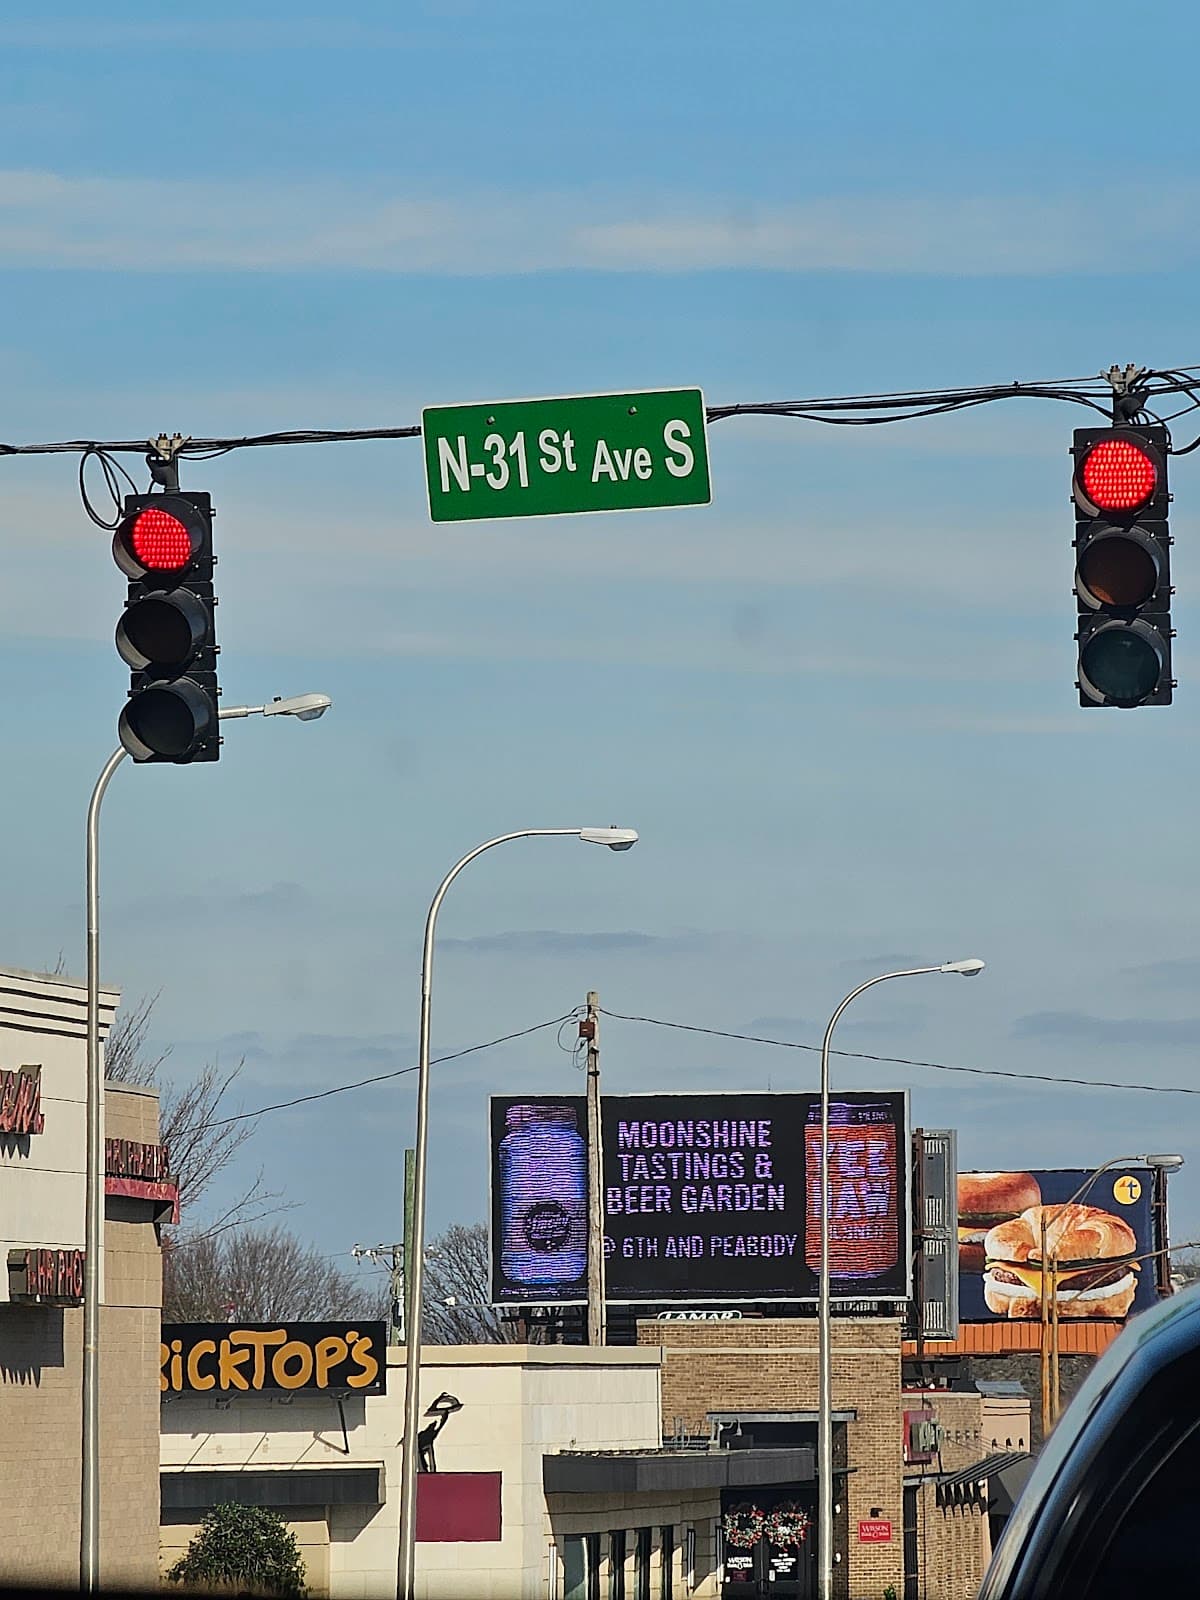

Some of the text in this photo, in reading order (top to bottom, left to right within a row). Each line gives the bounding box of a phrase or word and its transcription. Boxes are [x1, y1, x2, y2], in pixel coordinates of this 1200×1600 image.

[437, 419, 695, 493] N-31 St Ave S
[618, 1120, 772, 1149] MOONSHINE
[617, 1151, 773, 1181] TASTINGS &
[607, 1184, 785, 1215] BEER GARDEN
[623, 1236, 658, 1258] 6TH
[664, 1235, 704, 1258] AND
[710, 1234, 798, 1258] PEABODY
